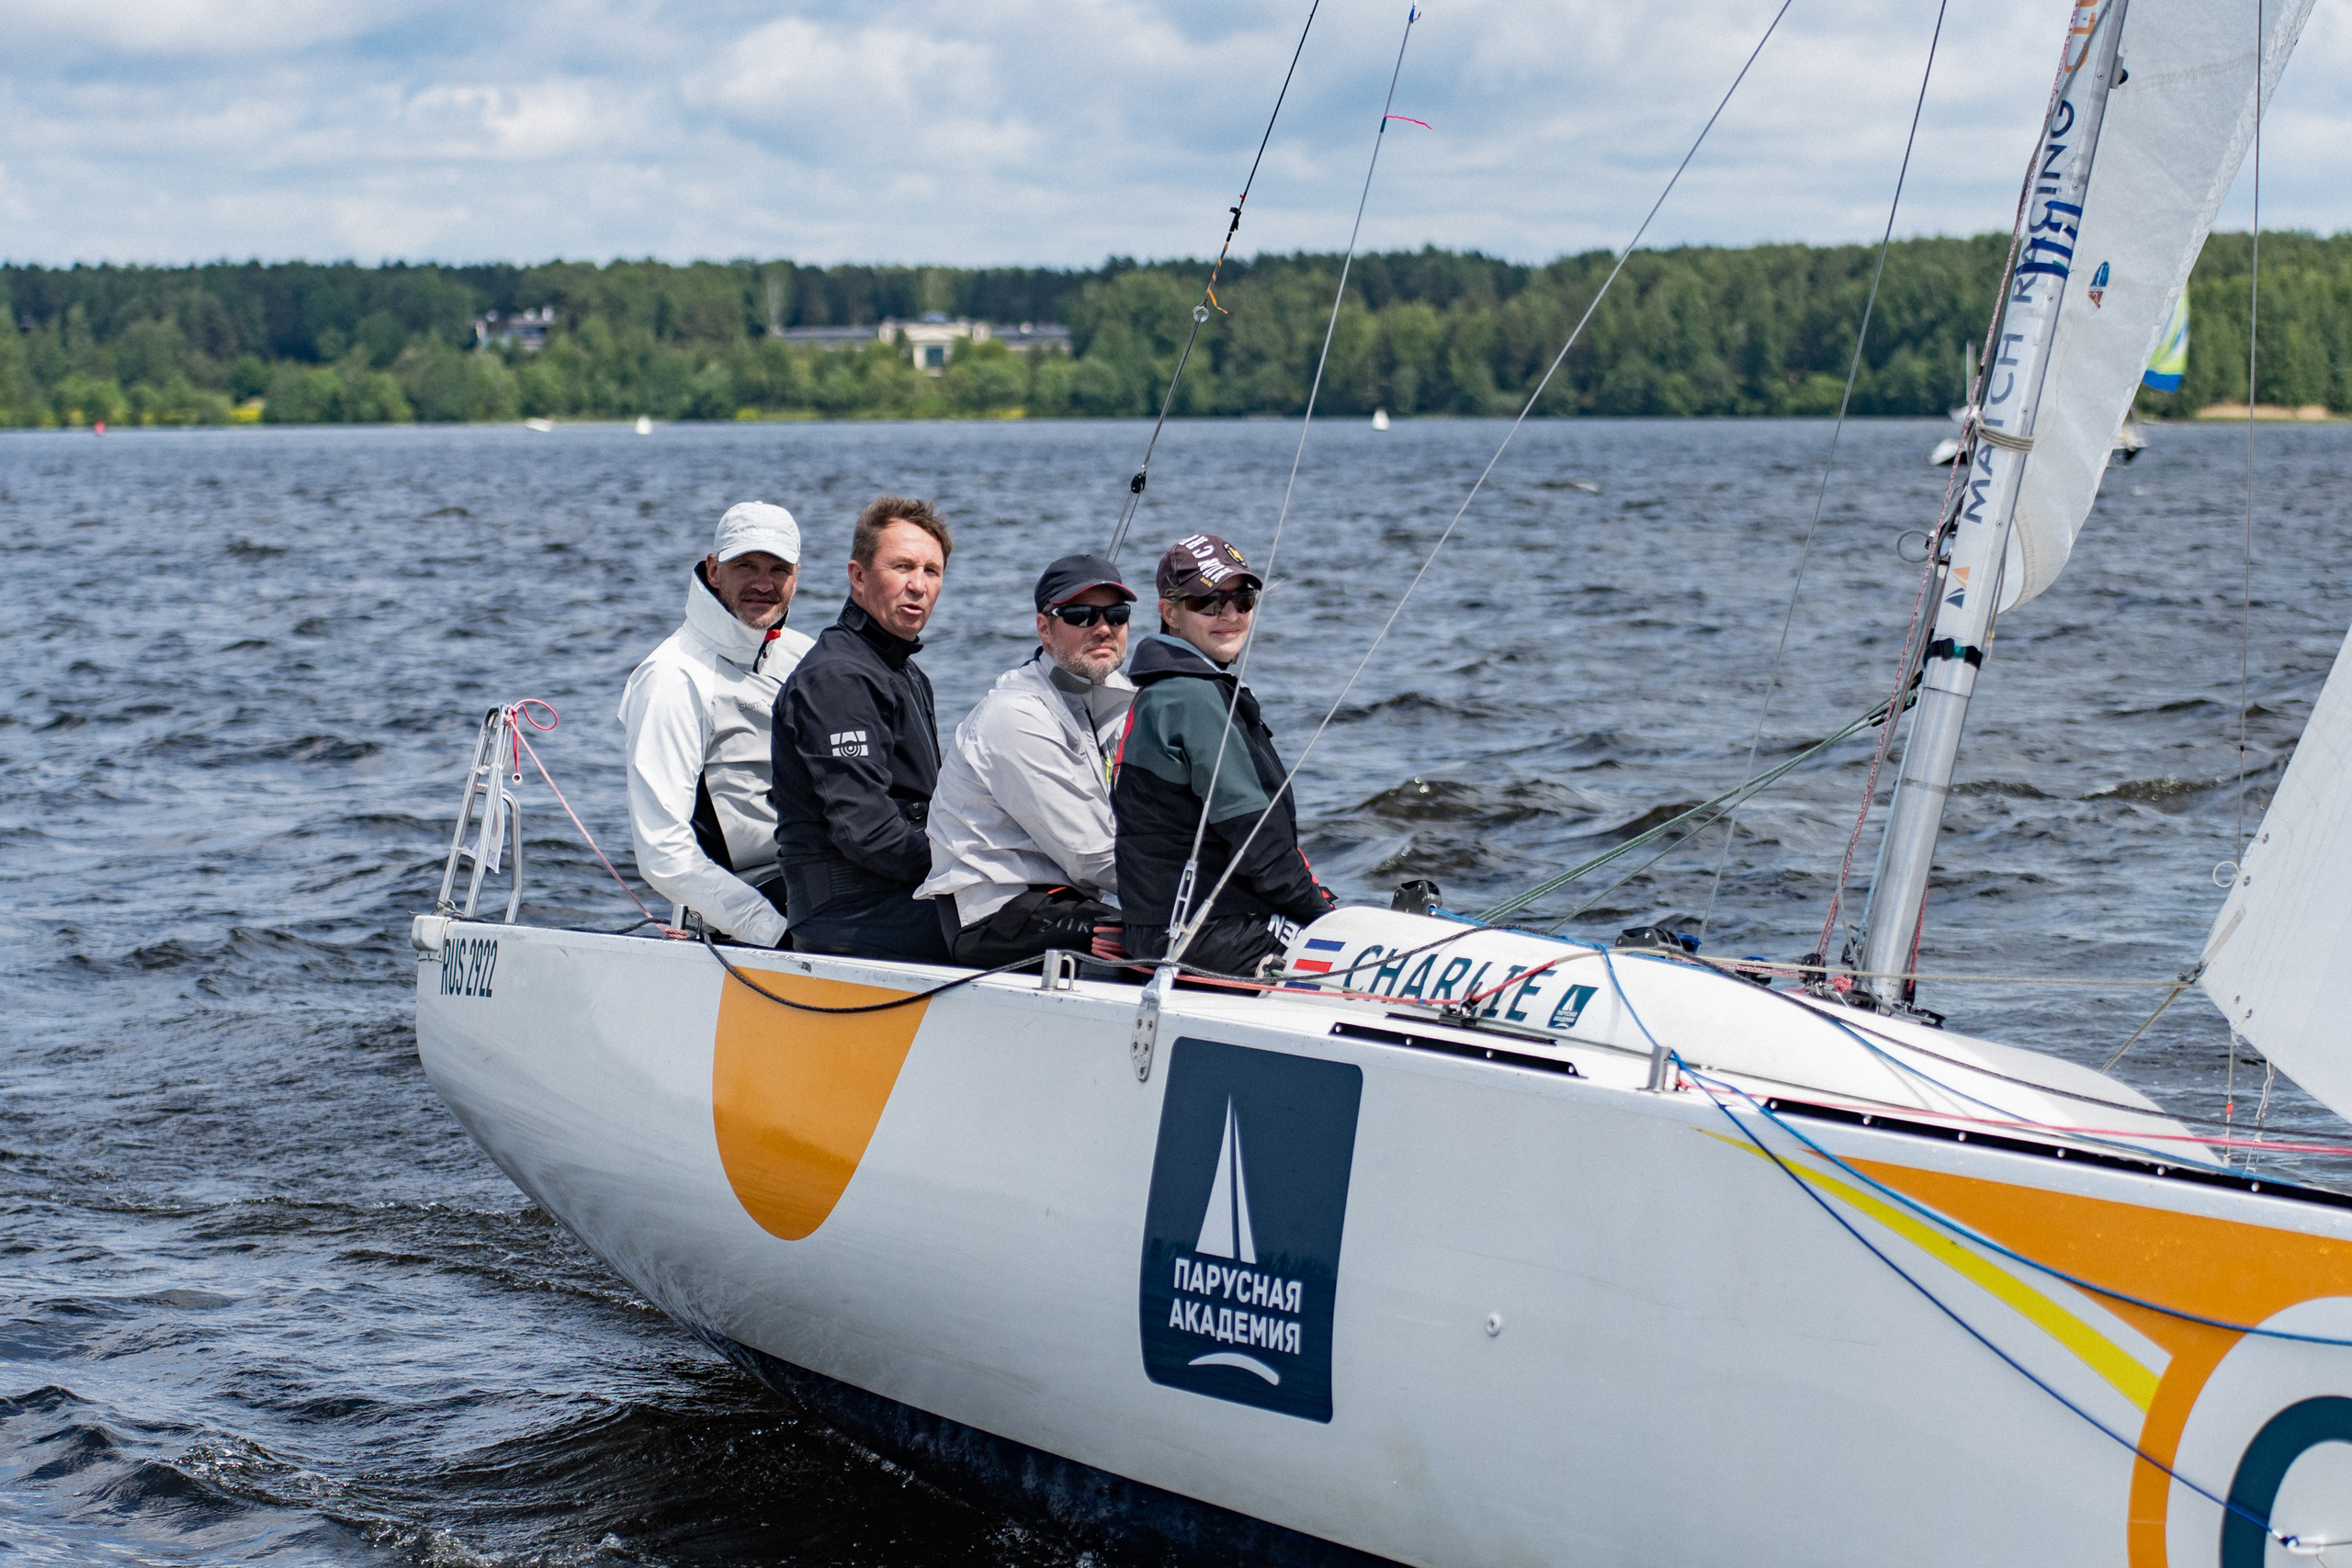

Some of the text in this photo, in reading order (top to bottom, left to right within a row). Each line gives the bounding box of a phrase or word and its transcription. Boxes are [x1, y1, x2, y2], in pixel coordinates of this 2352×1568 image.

[738, 701, 763, 713] Slam
[440, 937, 498, 998] RUS 2922
[1342, 944, 1558, 1022] CHARLIE
[1173, 1257, 1303, 1314] ПАРУСНАЯ
[1169, 1297, 1301, 1356] АКАДЕМИЯ
